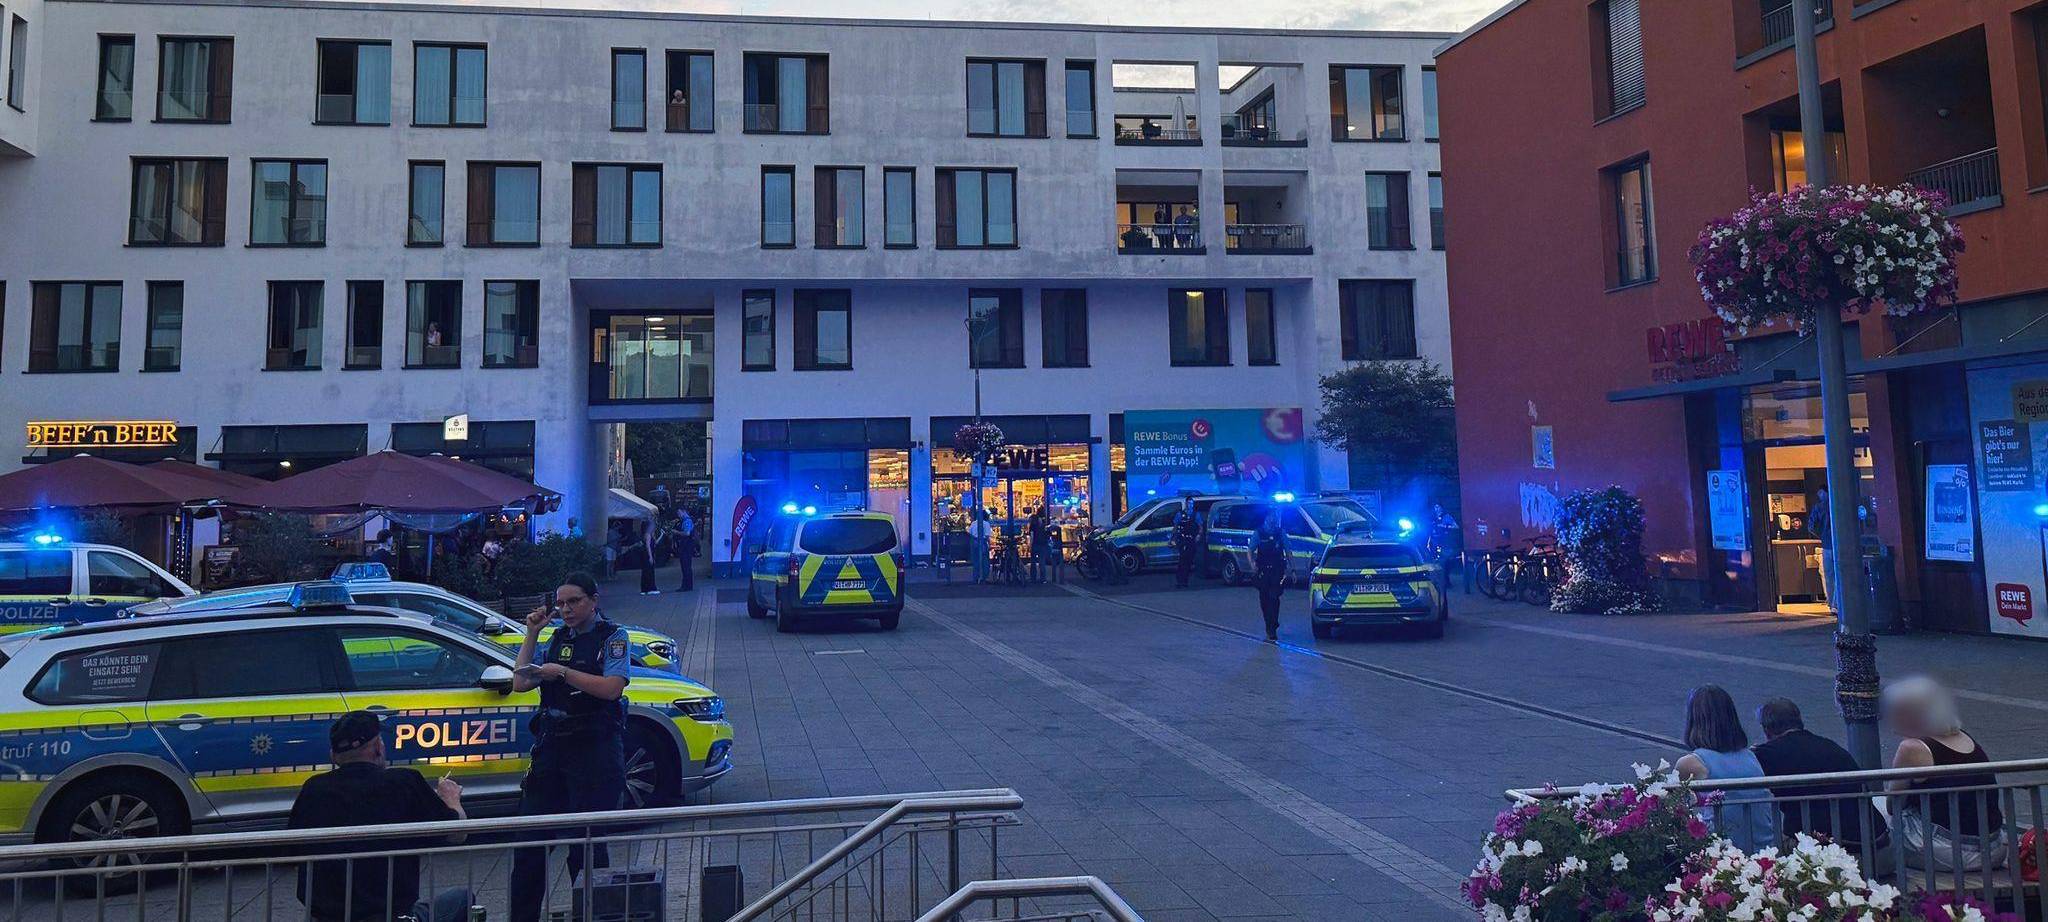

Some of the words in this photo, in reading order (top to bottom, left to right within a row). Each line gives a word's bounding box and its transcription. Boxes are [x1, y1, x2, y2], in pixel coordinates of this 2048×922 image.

[1646, 317, 1725, 362] REWE
[2018, 387, 2035, 400] Aus
[116, 423, 177, 442] BEER
[1133, 431, 1161, 441] REWE
[1162, 431, 1188, 441] Bonus
[1983, 427, 1998, 437] Das
[2000, 426, 2014, 437] Bier
[1134, 446, 1168, 455] Sammle
[1169, 445, 1193, 455] Euros
[1194, 445, 1203, 454] in
[1985, 440, 2006, 453] gibt's
[2007, 441, 2020, 449] nur
[1135, 458, 1149, 466] der
[1150, 457, 1177, 466] REWE
[1179, 456, 1199, 468] App!
[1986, 453, 2004, 464] hier!
[735, 505, 755, 537] REWE
[2000, 590, 2026, 602] REWE
[2001, 601, 2012, 609] Dein
[82, 658, 98, 667] DAS
[99, 655, 129, 666] KÖNNTE
[130, 655, 148, 664] DEIN
[89, 666, 119, 676] EINSATZ
[120, 664, 141, 674] SEIN!
[395, 719, 517, 749] POLIZEI
[40, 740, 71, 756] 110
